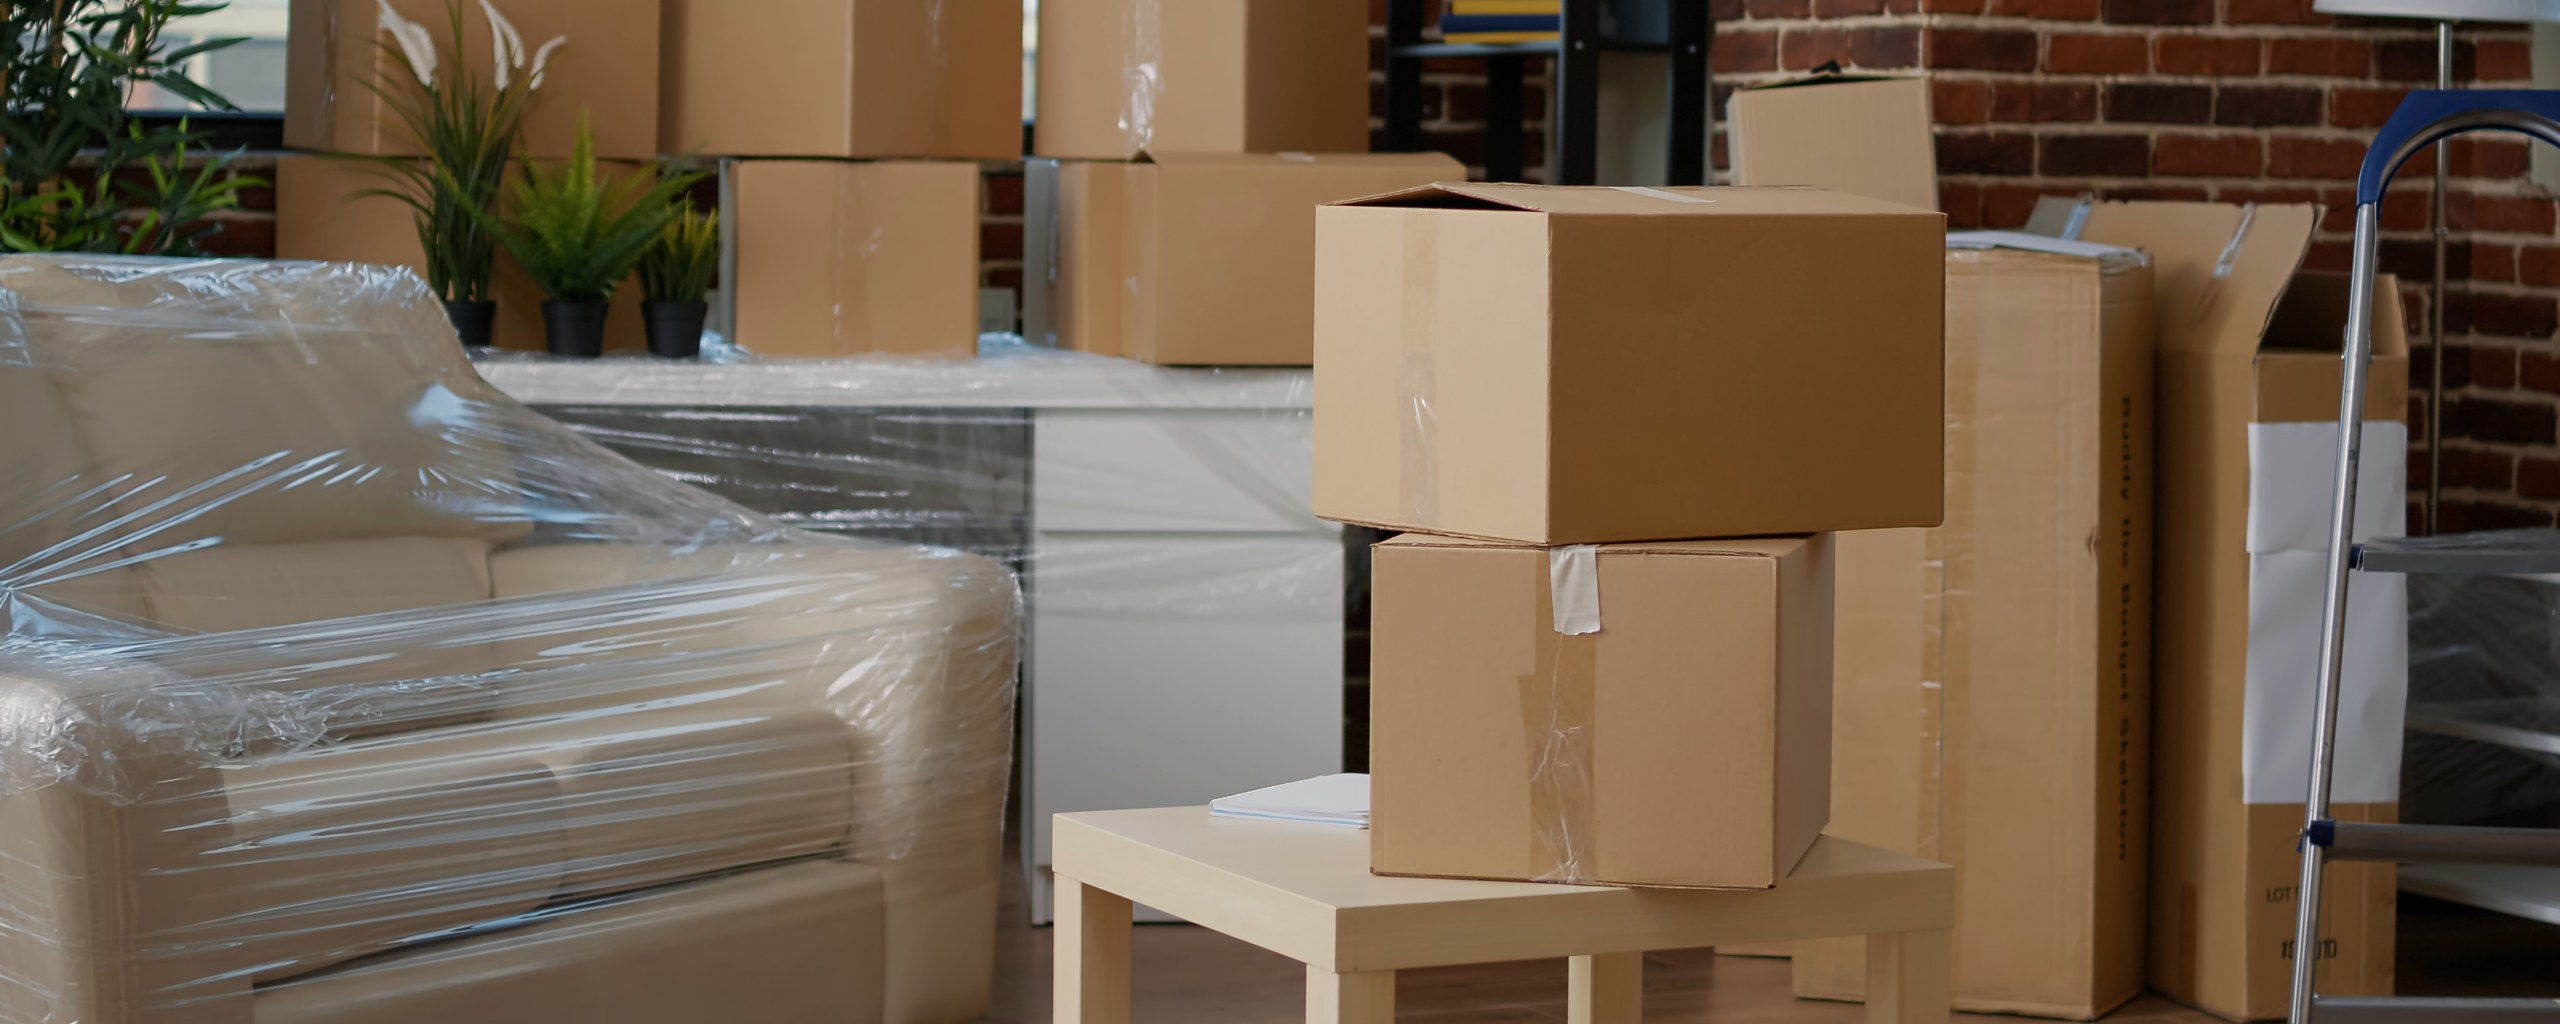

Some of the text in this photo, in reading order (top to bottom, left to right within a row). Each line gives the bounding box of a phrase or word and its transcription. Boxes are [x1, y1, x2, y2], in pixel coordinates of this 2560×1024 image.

[2118, 397, 2131, 861] Buddy the Budget Skeleton
[2266, 886, 2291, 902] LOT
